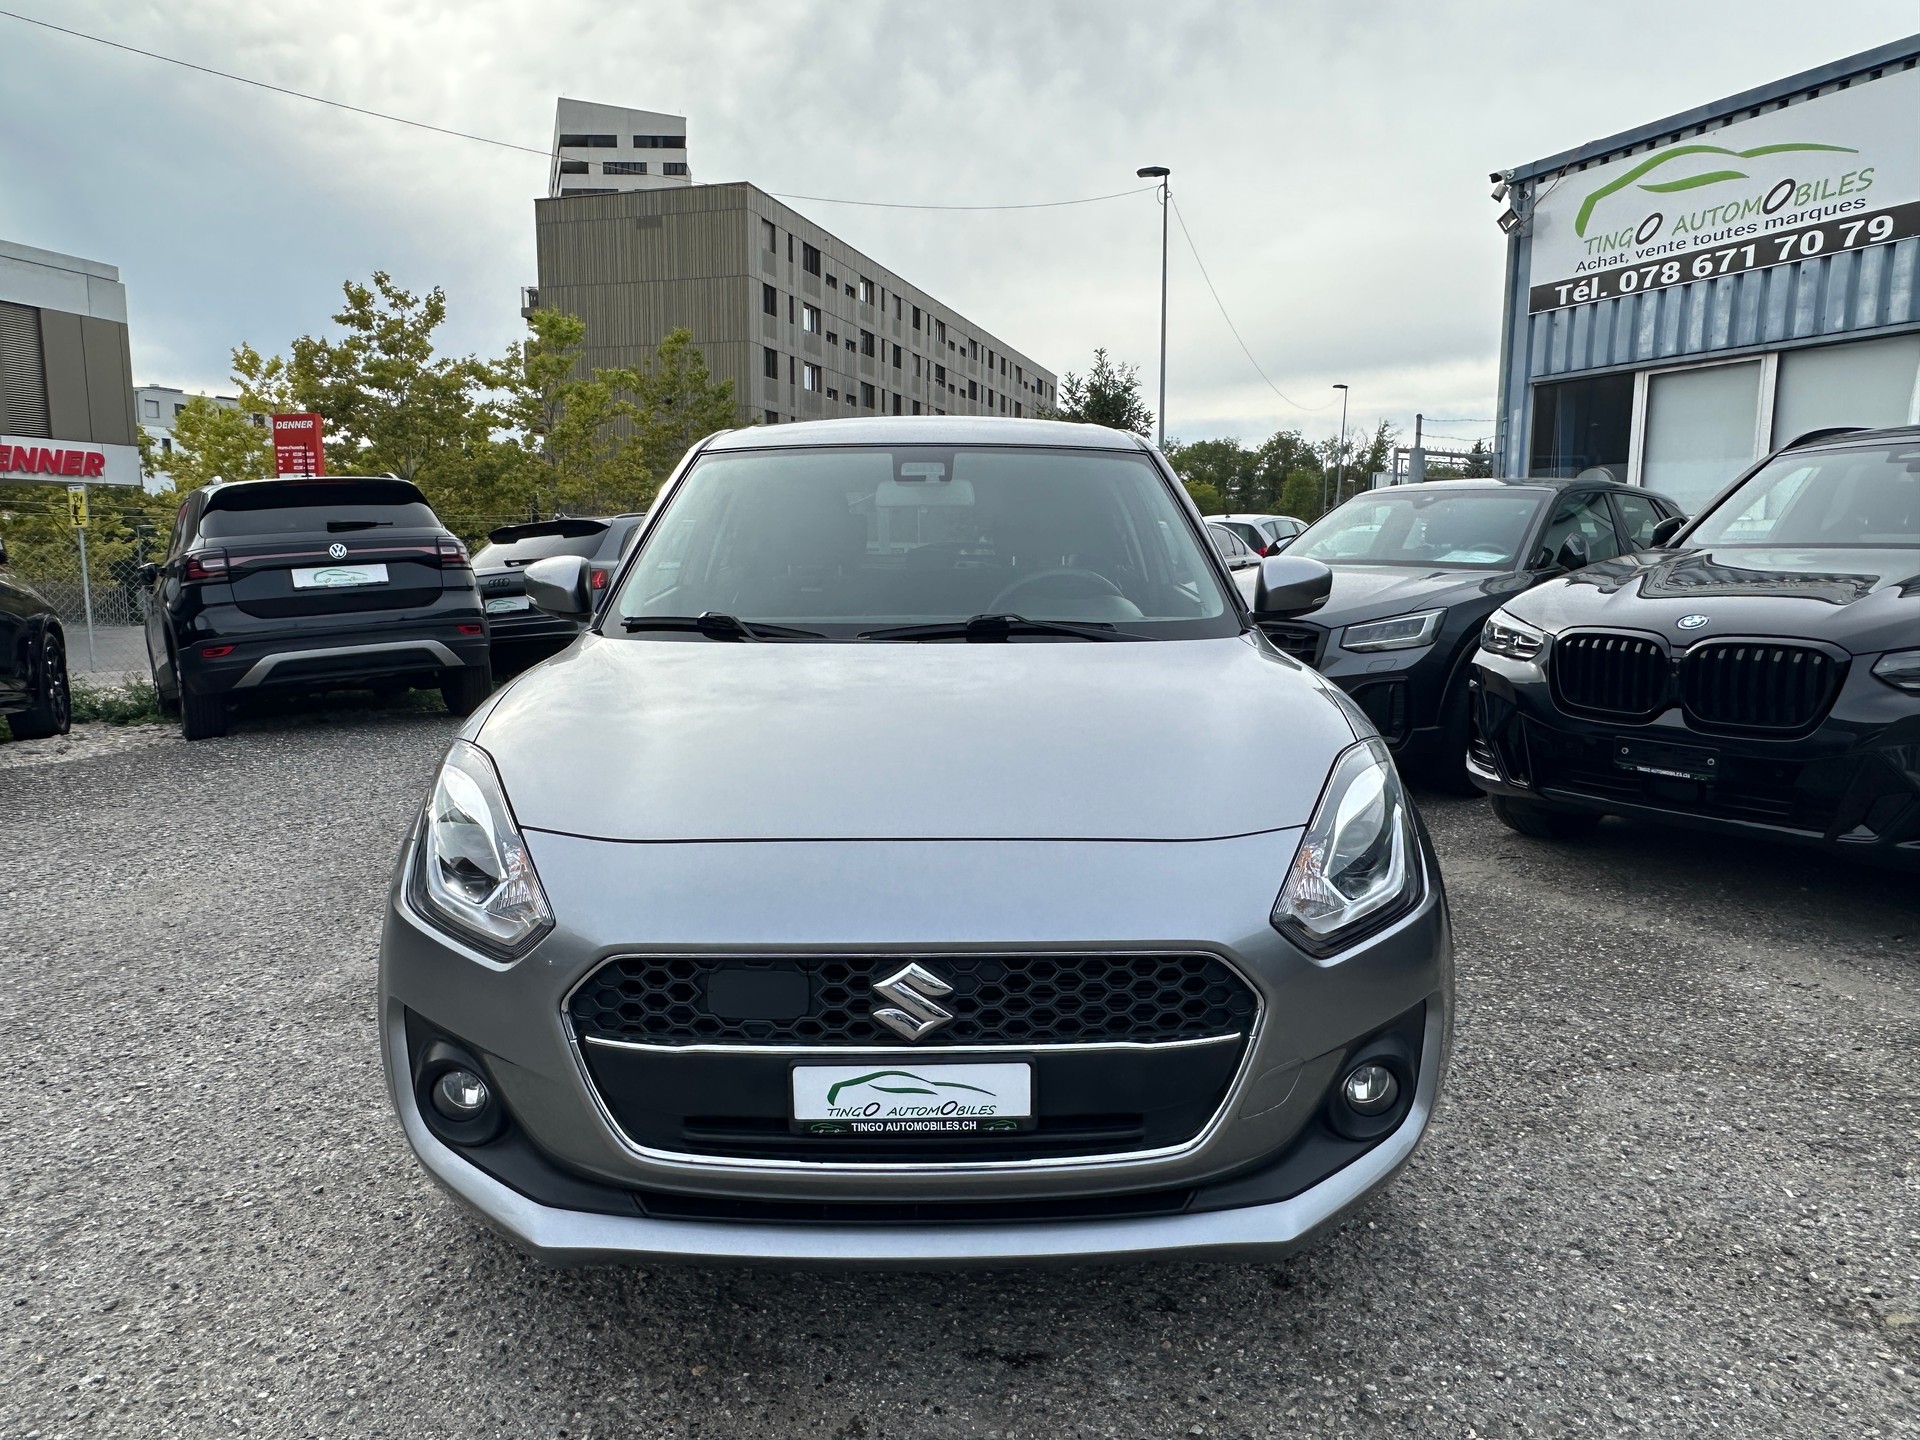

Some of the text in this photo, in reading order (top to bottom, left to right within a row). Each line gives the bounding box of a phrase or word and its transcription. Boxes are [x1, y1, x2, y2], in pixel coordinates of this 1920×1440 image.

[1575, 197, 1867, 273] Achat, vente toutes marques
[1583, 167, 1876, 256] TINGO AUTOMOBILES
[1554, 214, 1895, 306] Tél. 078 671 70 79
[275, 420, 314, 430] DENNER
[827, 1100, 997, 1118] TINGO AUTOMOBILES
[851, 1122, 884, 1132] TINGO
[885, 1121, 977, 1132] AUTOMOBILES.CH
